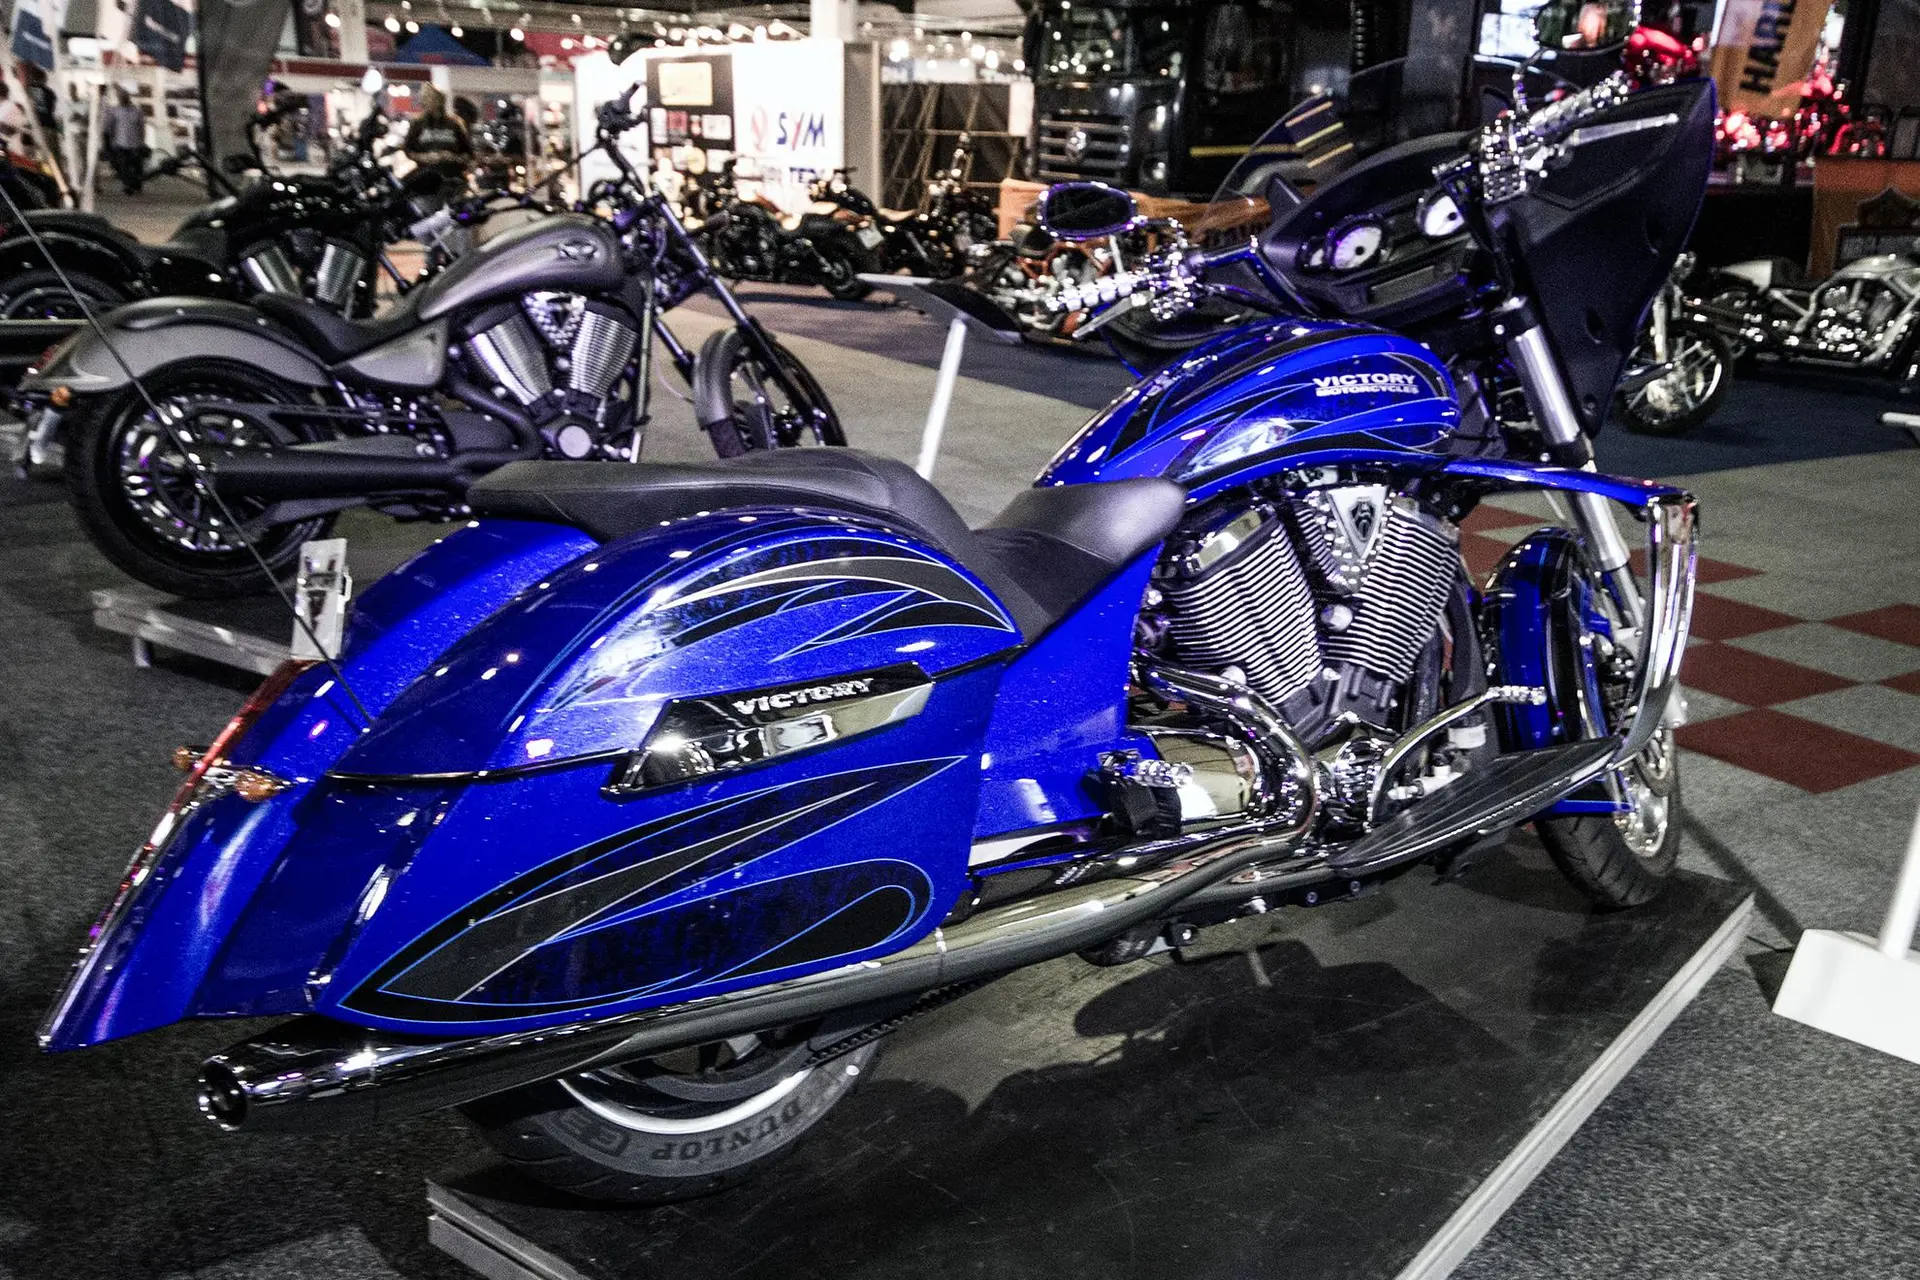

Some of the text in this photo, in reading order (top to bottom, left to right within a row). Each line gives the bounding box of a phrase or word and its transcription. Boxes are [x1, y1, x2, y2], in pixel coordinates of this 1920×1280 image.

[776, 112, 825, 151] SYM
[1312, 373, 1415, 387] VICTORY
[1315, 384, 1419, 396] MOTORCYCLES
[732, 678, 874, 714] VICTORY
[651, 1099, 801, 1161] DUNLOP
